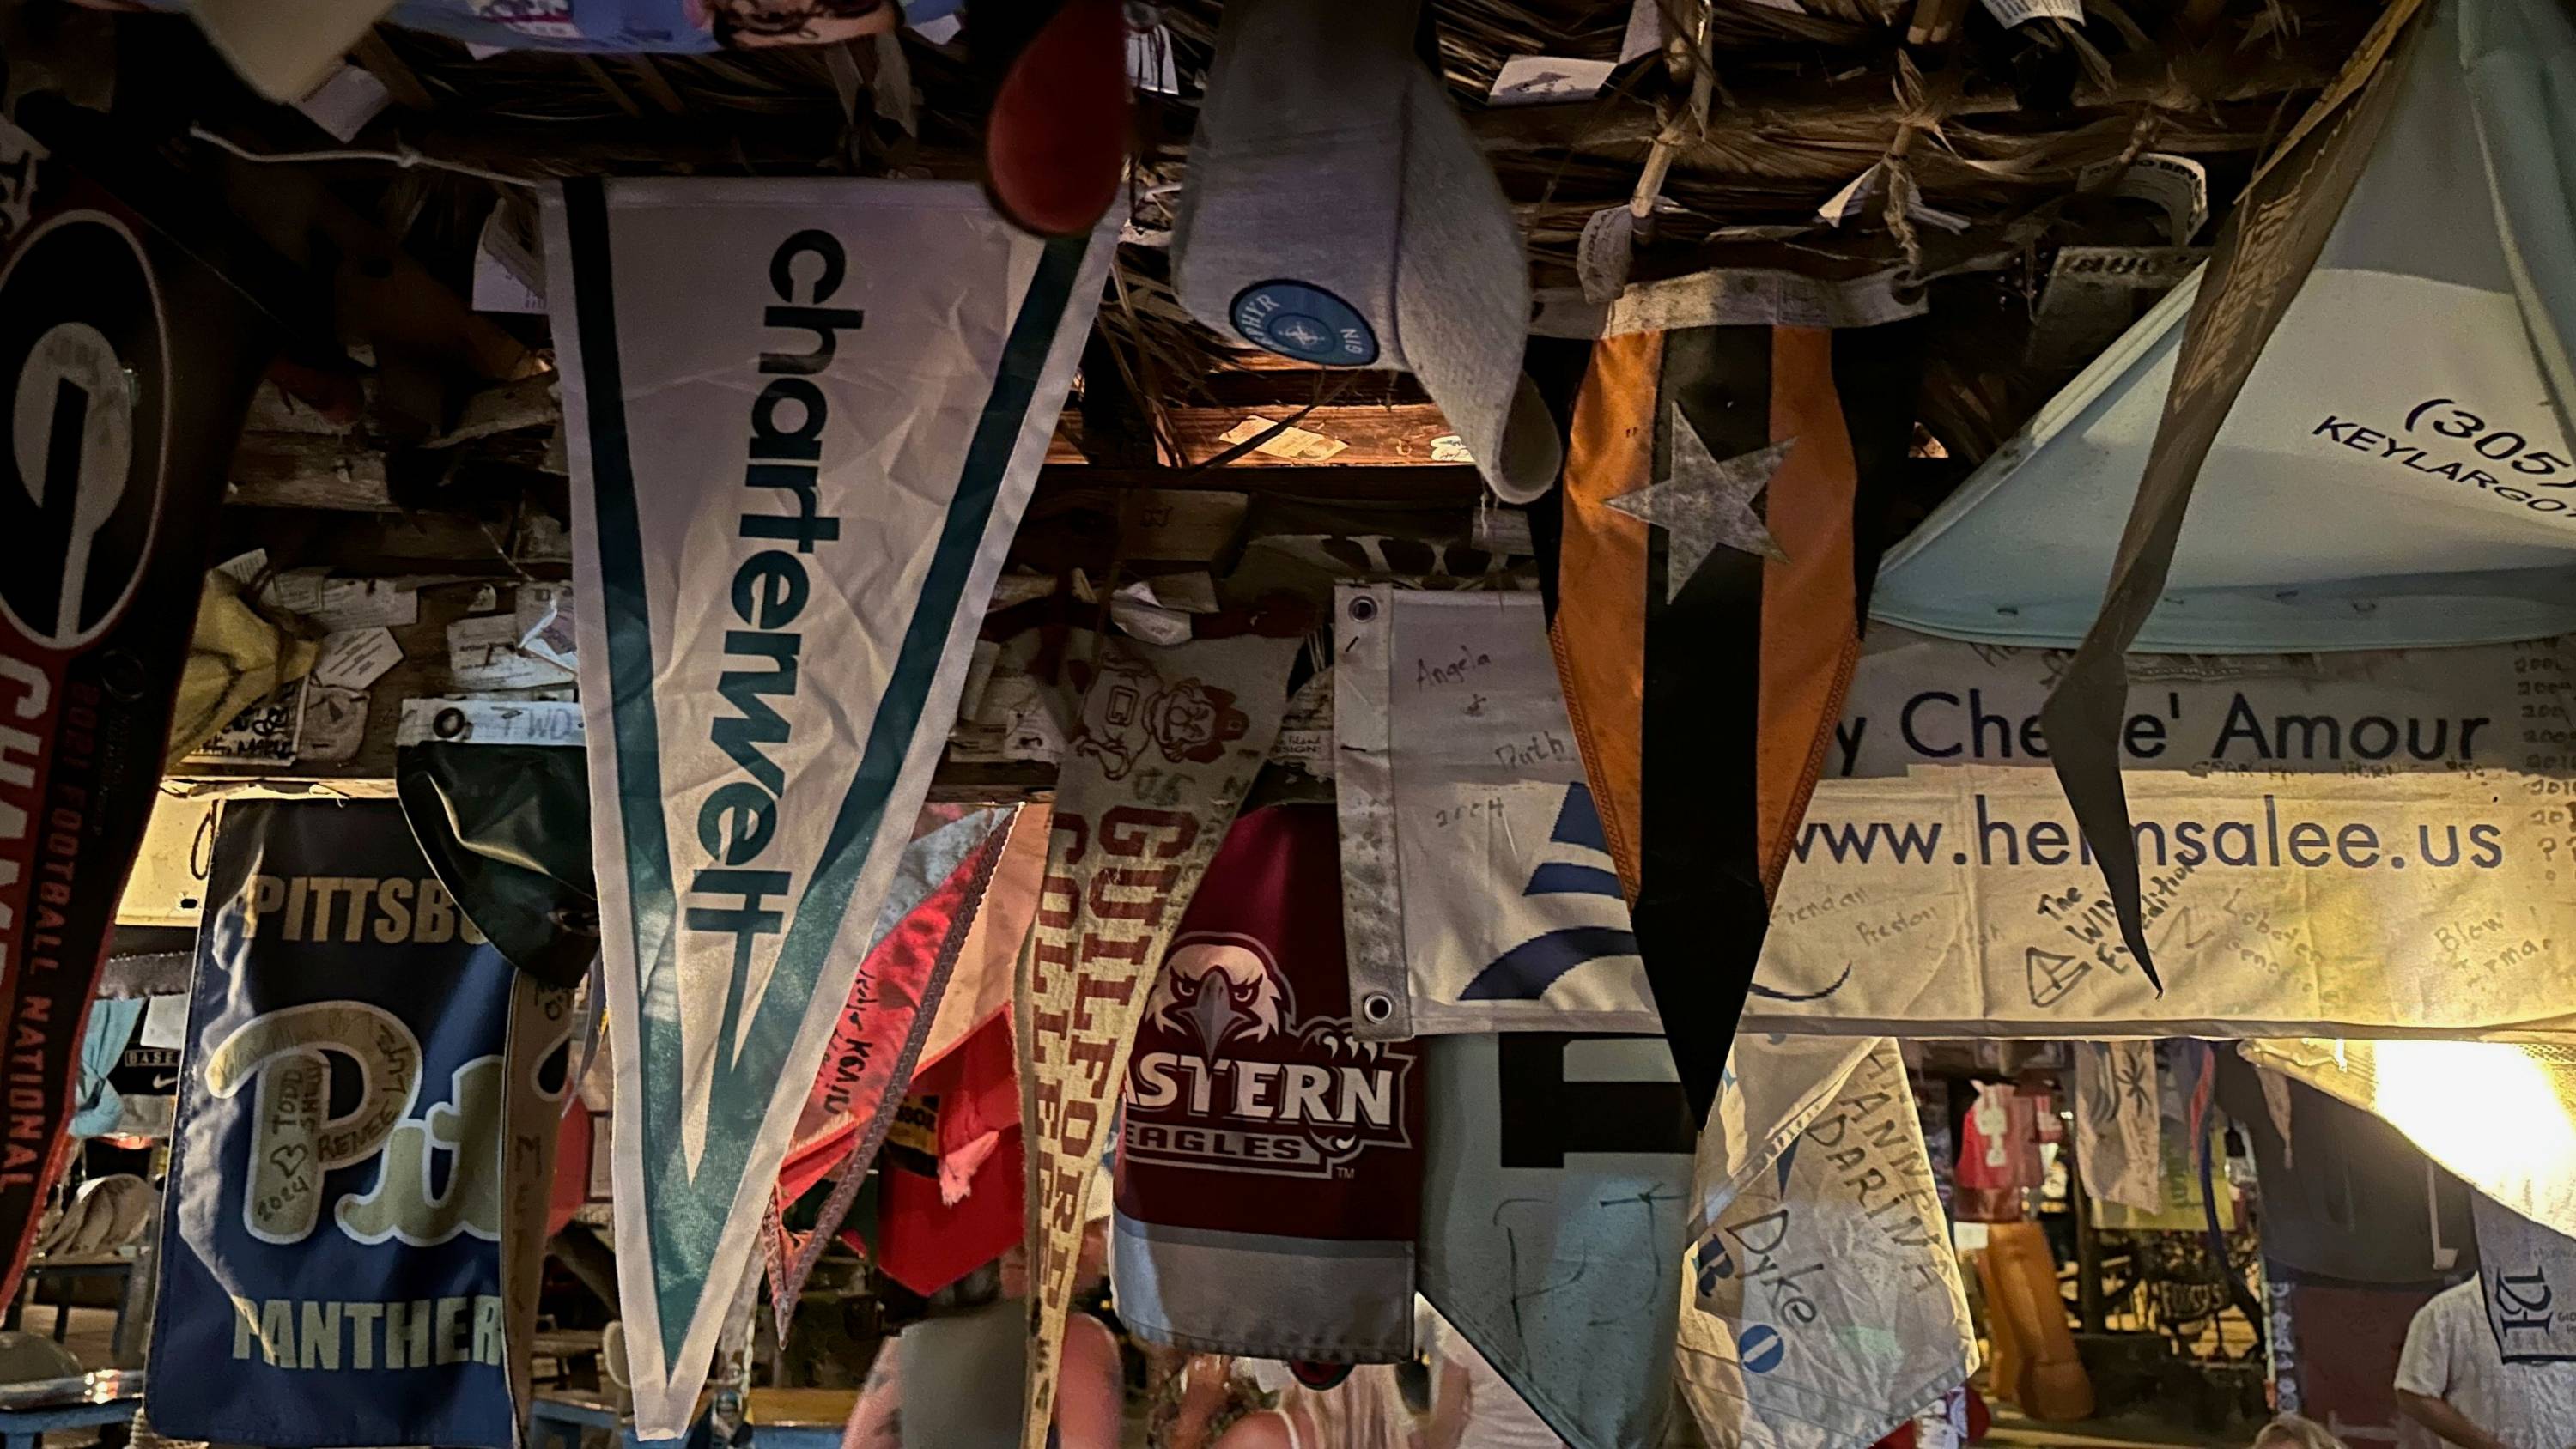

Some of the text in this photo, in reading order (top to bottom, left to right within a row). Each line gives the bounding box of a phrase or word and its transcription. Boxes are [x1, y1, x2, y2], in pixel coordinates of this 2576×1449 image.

[1340, 328, 1364, 354] GIN
[2312, 415, 2576, 517] KEYLARGO
[1416, 645, 1492, 692] Angela
[1836, 689, 2490, 777] y Chee' Amour
[28, 782, 90, 977] FOOTBALL
[2037, 887, 2083, 921] The
[0, 996, 53, 1192] NATIONAL
[1032, 811, 1091, 1288] COLLEGE
[1047, 804, 1200, 1309] GUILFORD
[1338, 1168, 1357, 1179] TM
